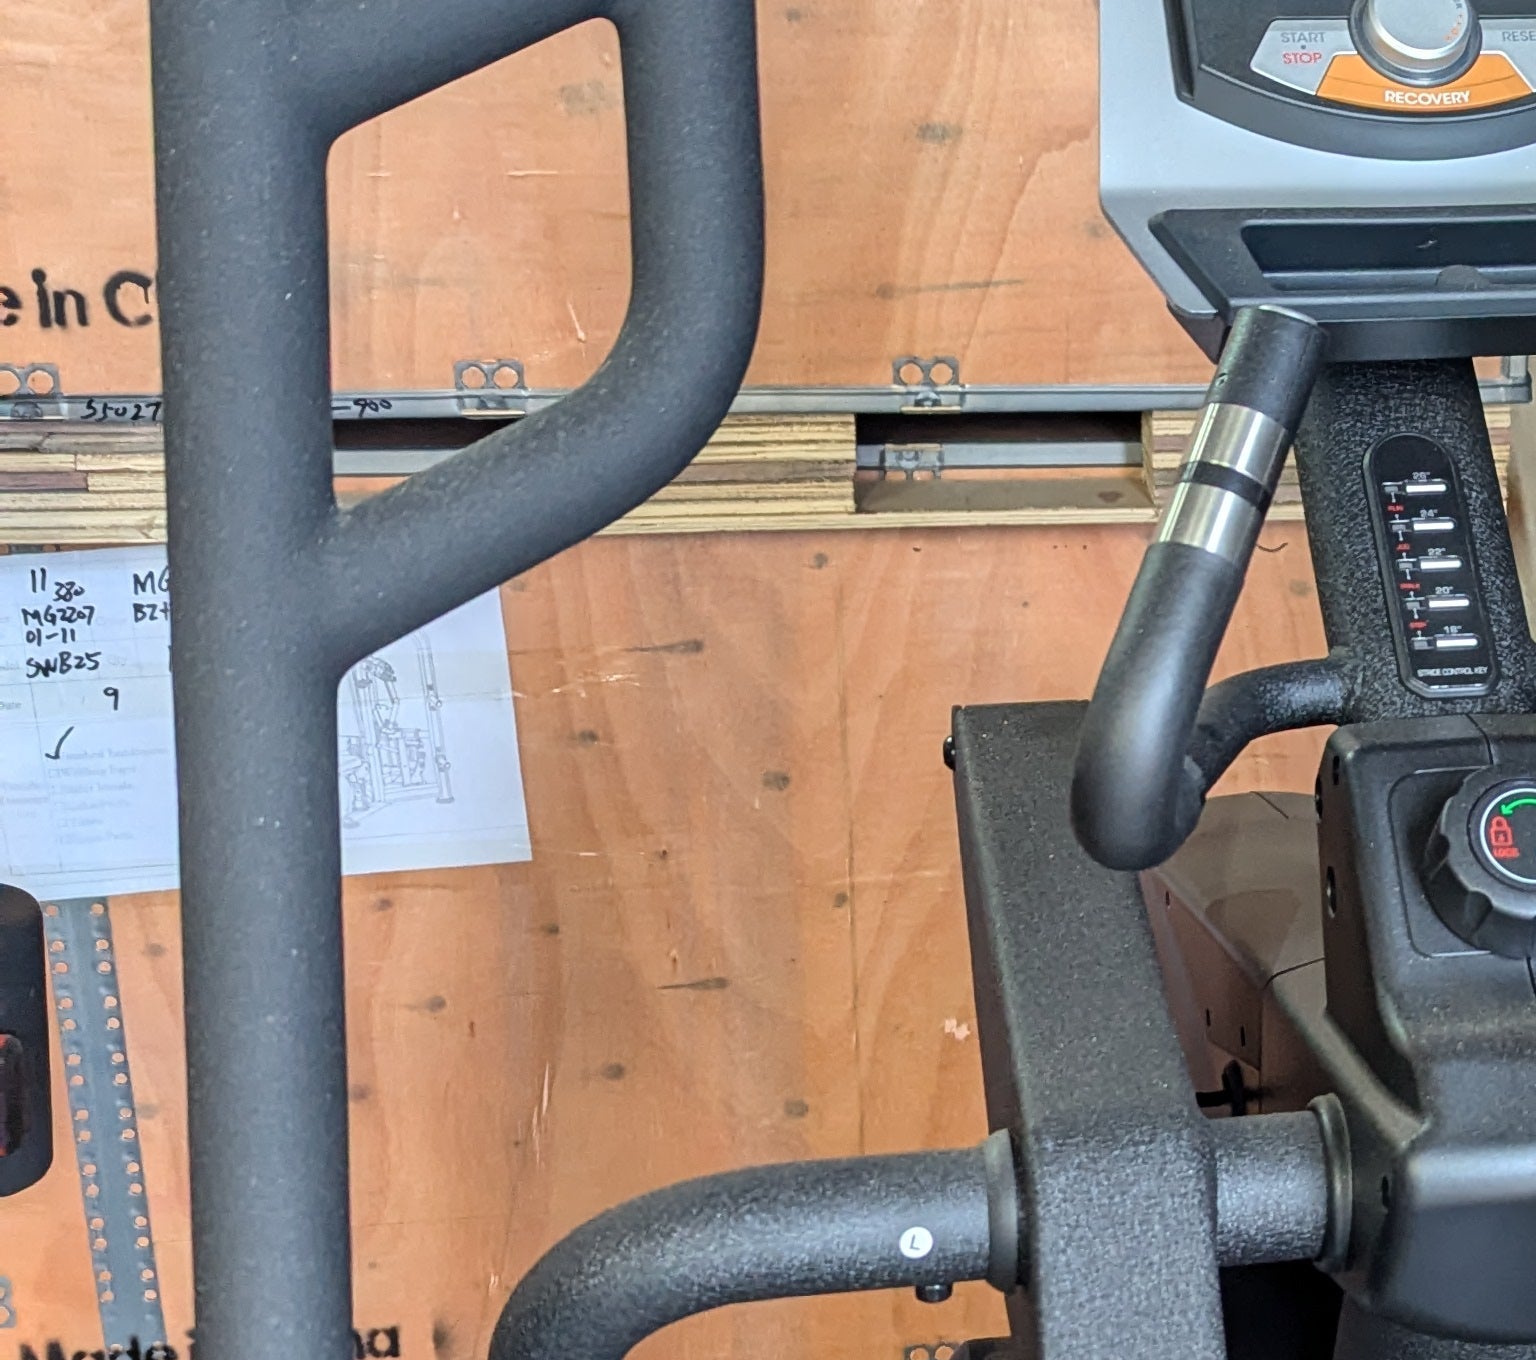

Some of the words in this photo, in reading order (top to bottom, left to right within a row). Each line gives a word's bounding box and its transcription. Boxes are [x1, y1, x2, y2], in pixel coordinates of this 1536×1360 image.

[1281, 31, 1326, 43] START
[1283, 52, 1322, 65] STOP
[1384, 90, 1470, 105] RECOVERY
[31, 267, 89, 329] in
[1474, 666, 1489, 675] KEY
